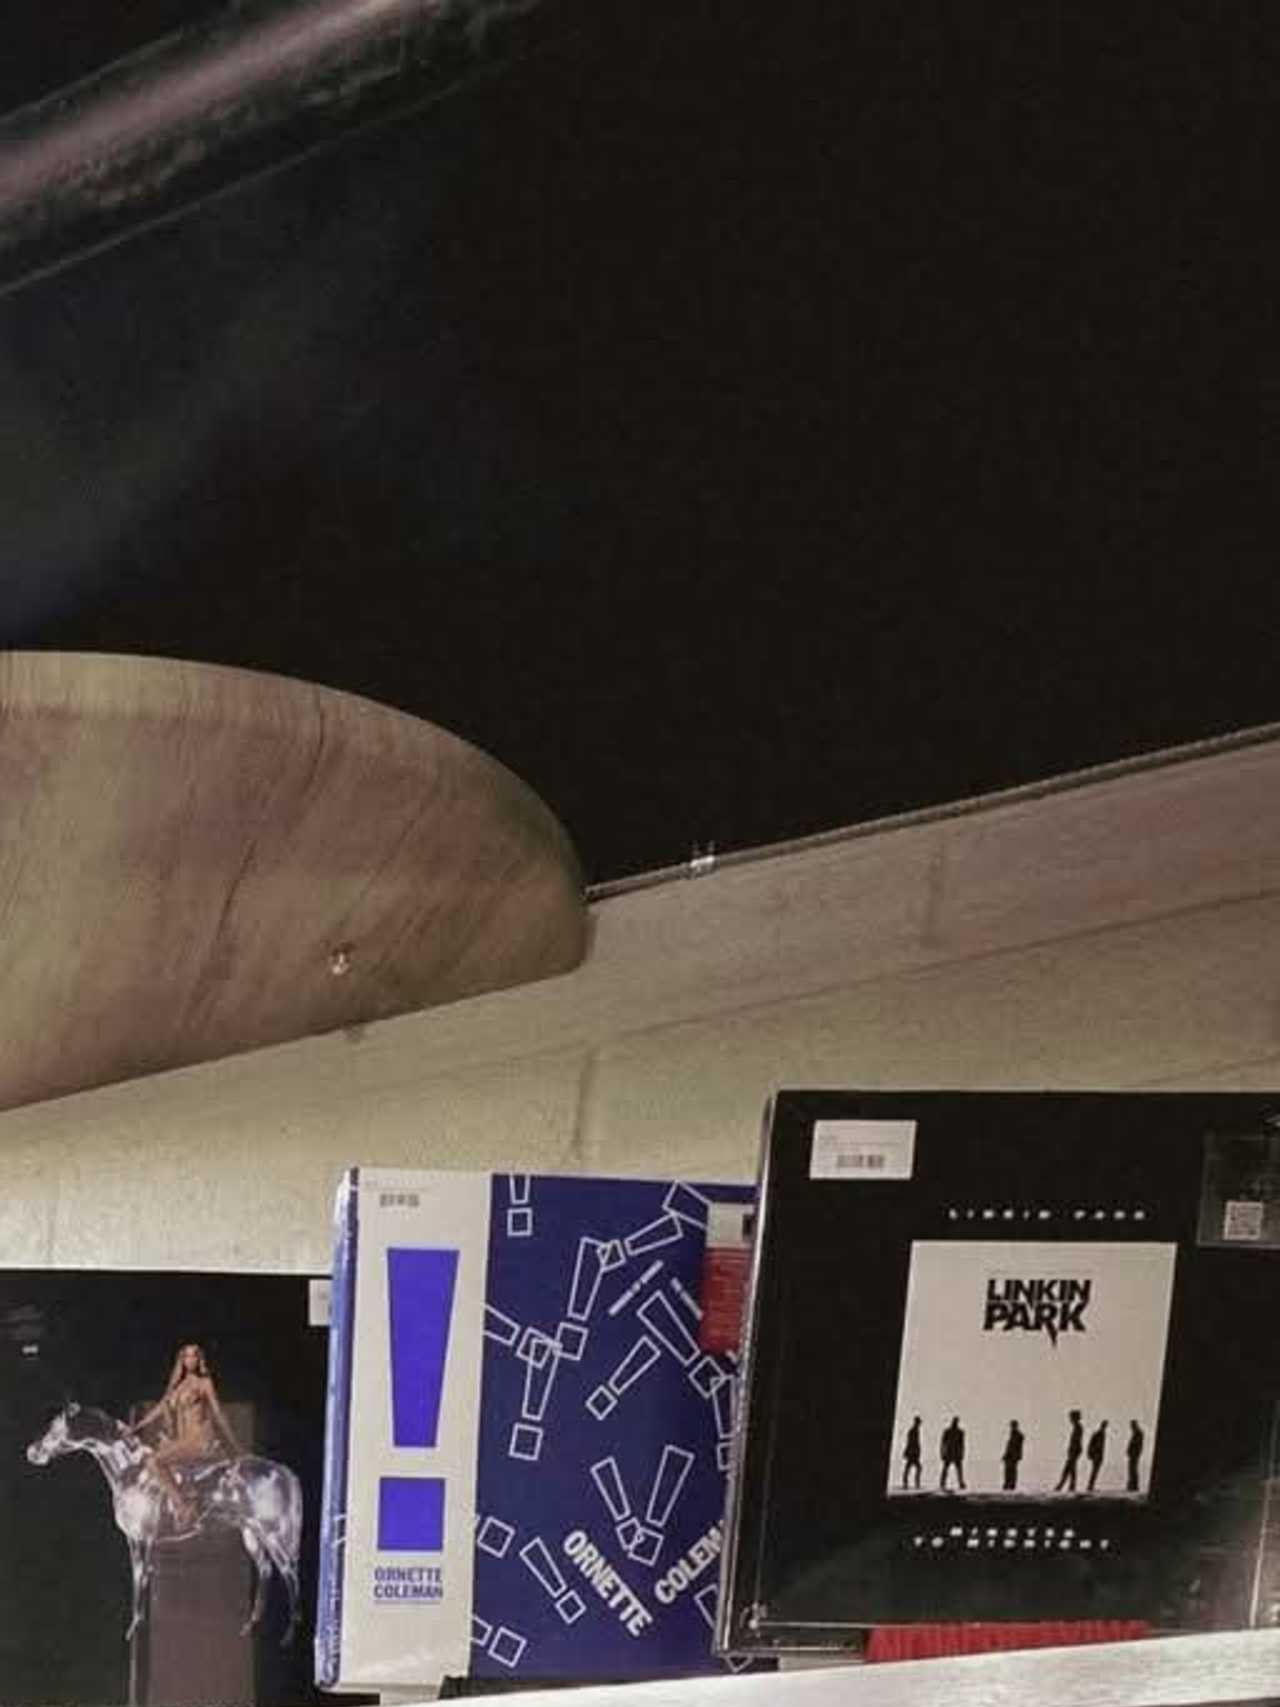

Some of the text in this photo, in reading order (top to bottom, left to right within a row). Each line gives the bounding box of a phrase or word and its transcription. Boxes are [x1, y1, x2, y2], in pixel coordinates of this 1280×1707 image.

[986, 1279, 1092, 1301] LINKIN
[983, 1302, 1090, 1347] PARK
[563, 1529, 653, 1637] ORNETTE
[655, 1518, 725, 1605] COLEM
